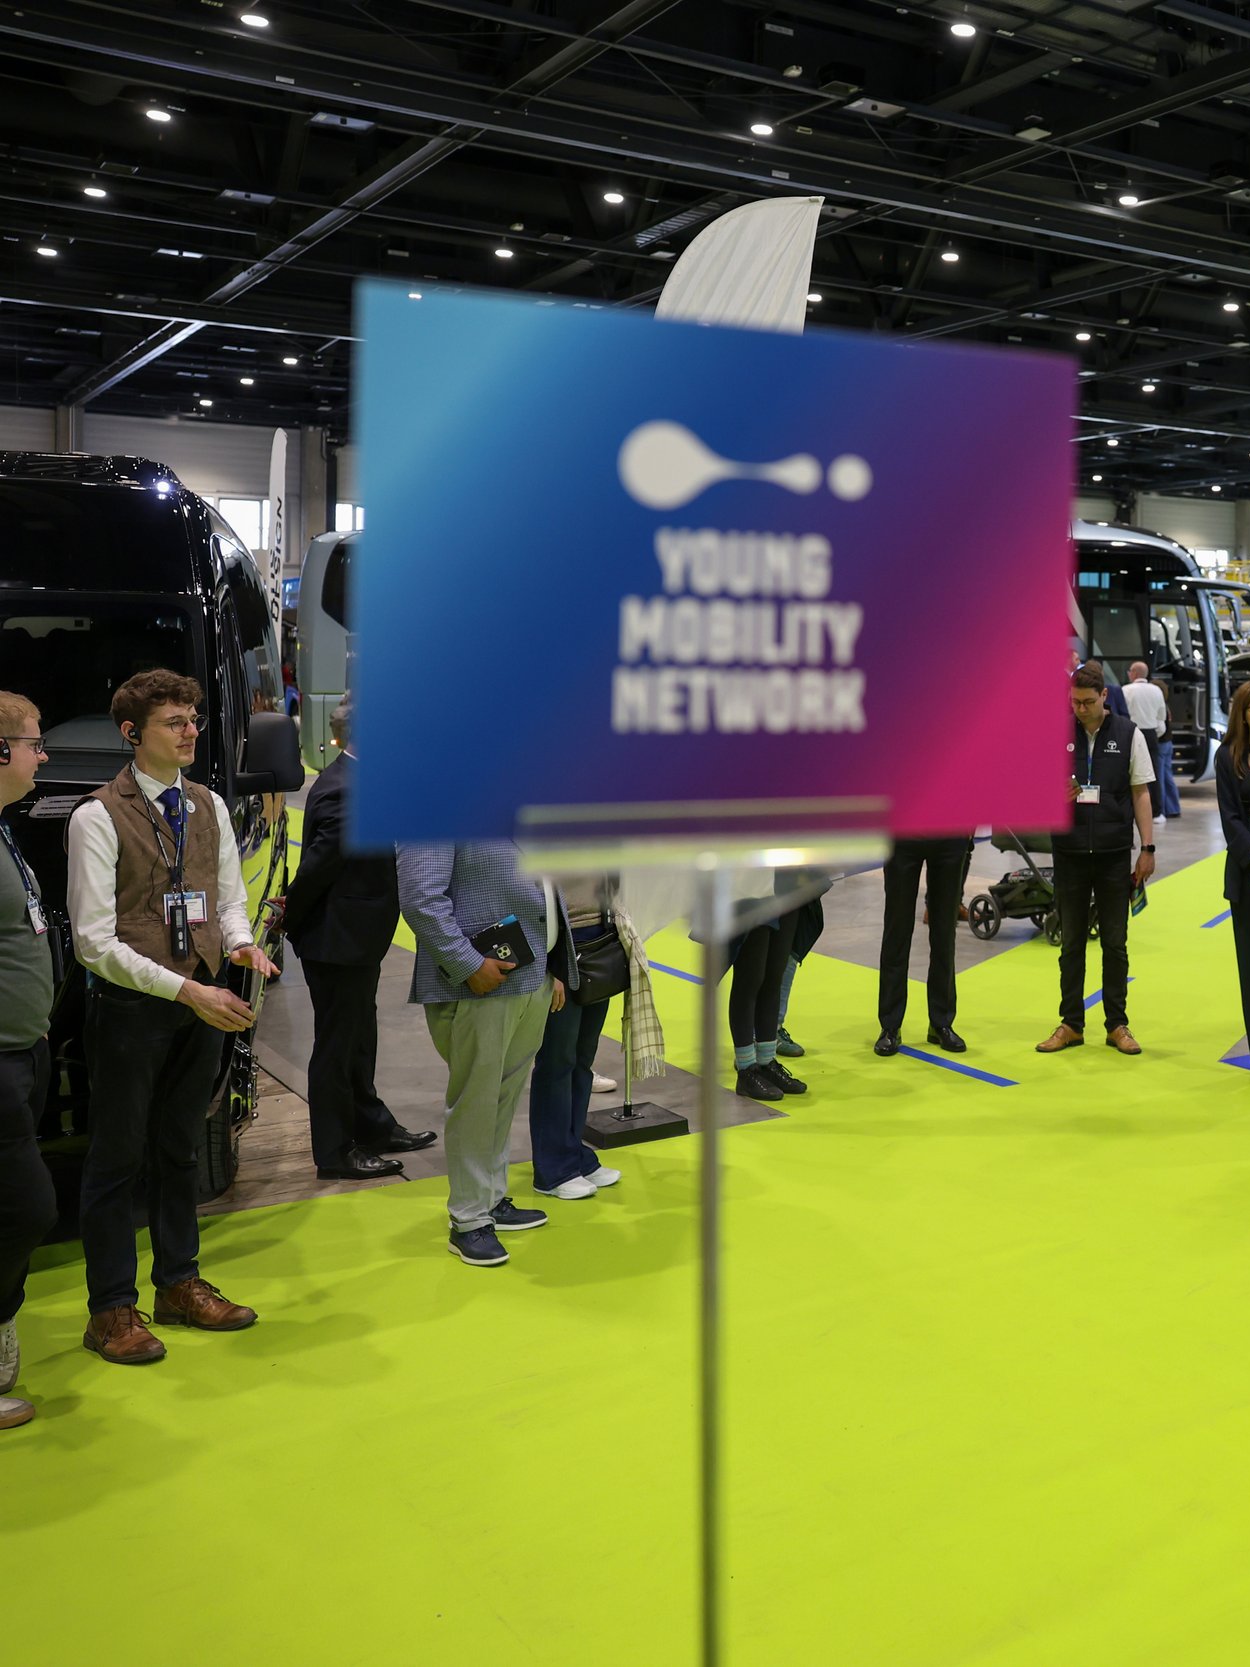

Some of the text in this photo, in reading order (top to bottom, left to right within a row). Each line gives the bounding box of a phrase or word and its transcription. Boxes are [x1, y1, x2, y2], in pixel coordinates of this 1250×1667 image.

[654, 527, 832, 598] YOUNG
[618, 595, 864, 665] MOBILITY
[611, 666, 867, 734] NETWORK
